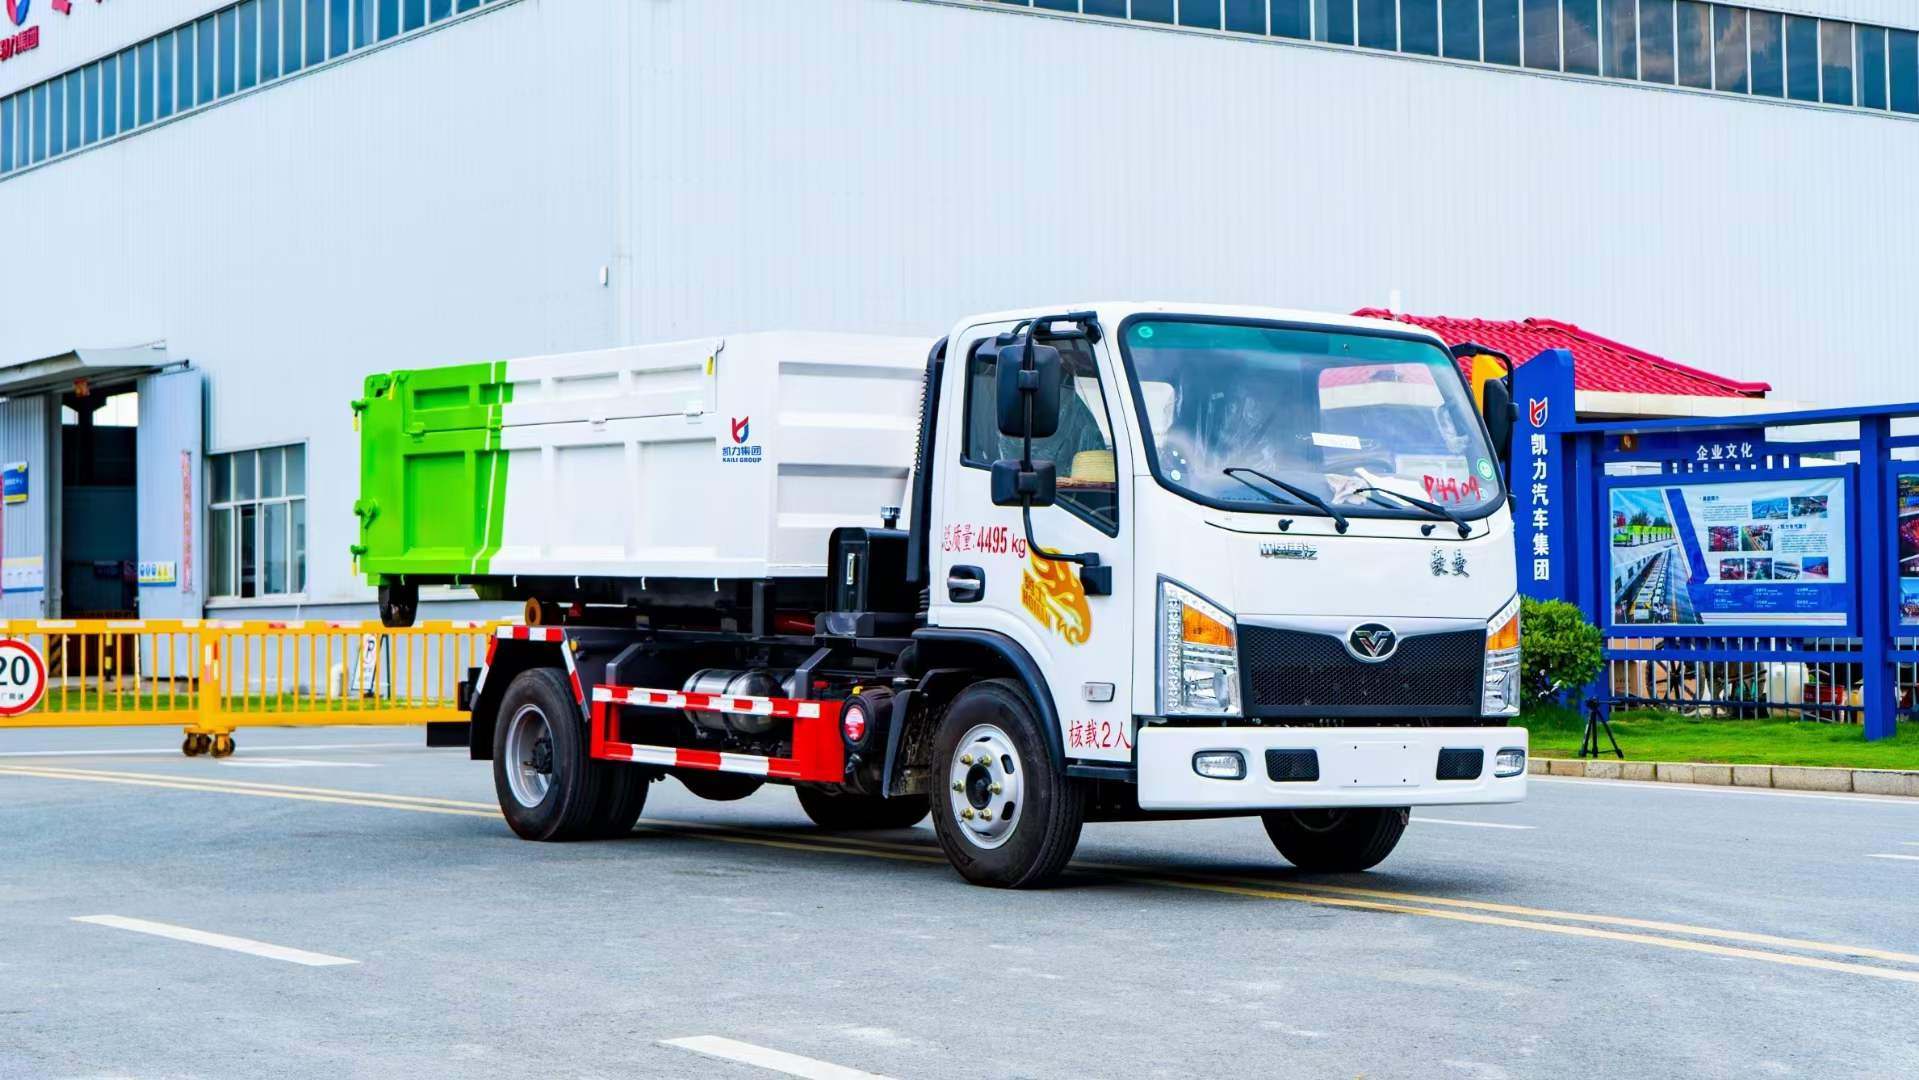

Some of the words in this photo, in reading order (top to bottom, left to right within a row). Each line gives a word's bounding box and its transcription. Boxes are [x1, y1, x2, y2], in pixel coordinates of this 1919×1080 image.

[722, 446, 762, 456] 凯力集团
[1697, 442, 1753, 461] 企业文化
[1531, 433, 1549, 581] 凯力汽车集团
[1011, 533, 1026, 559] kg
[1069, 719, 1133, 749] 核载2人
